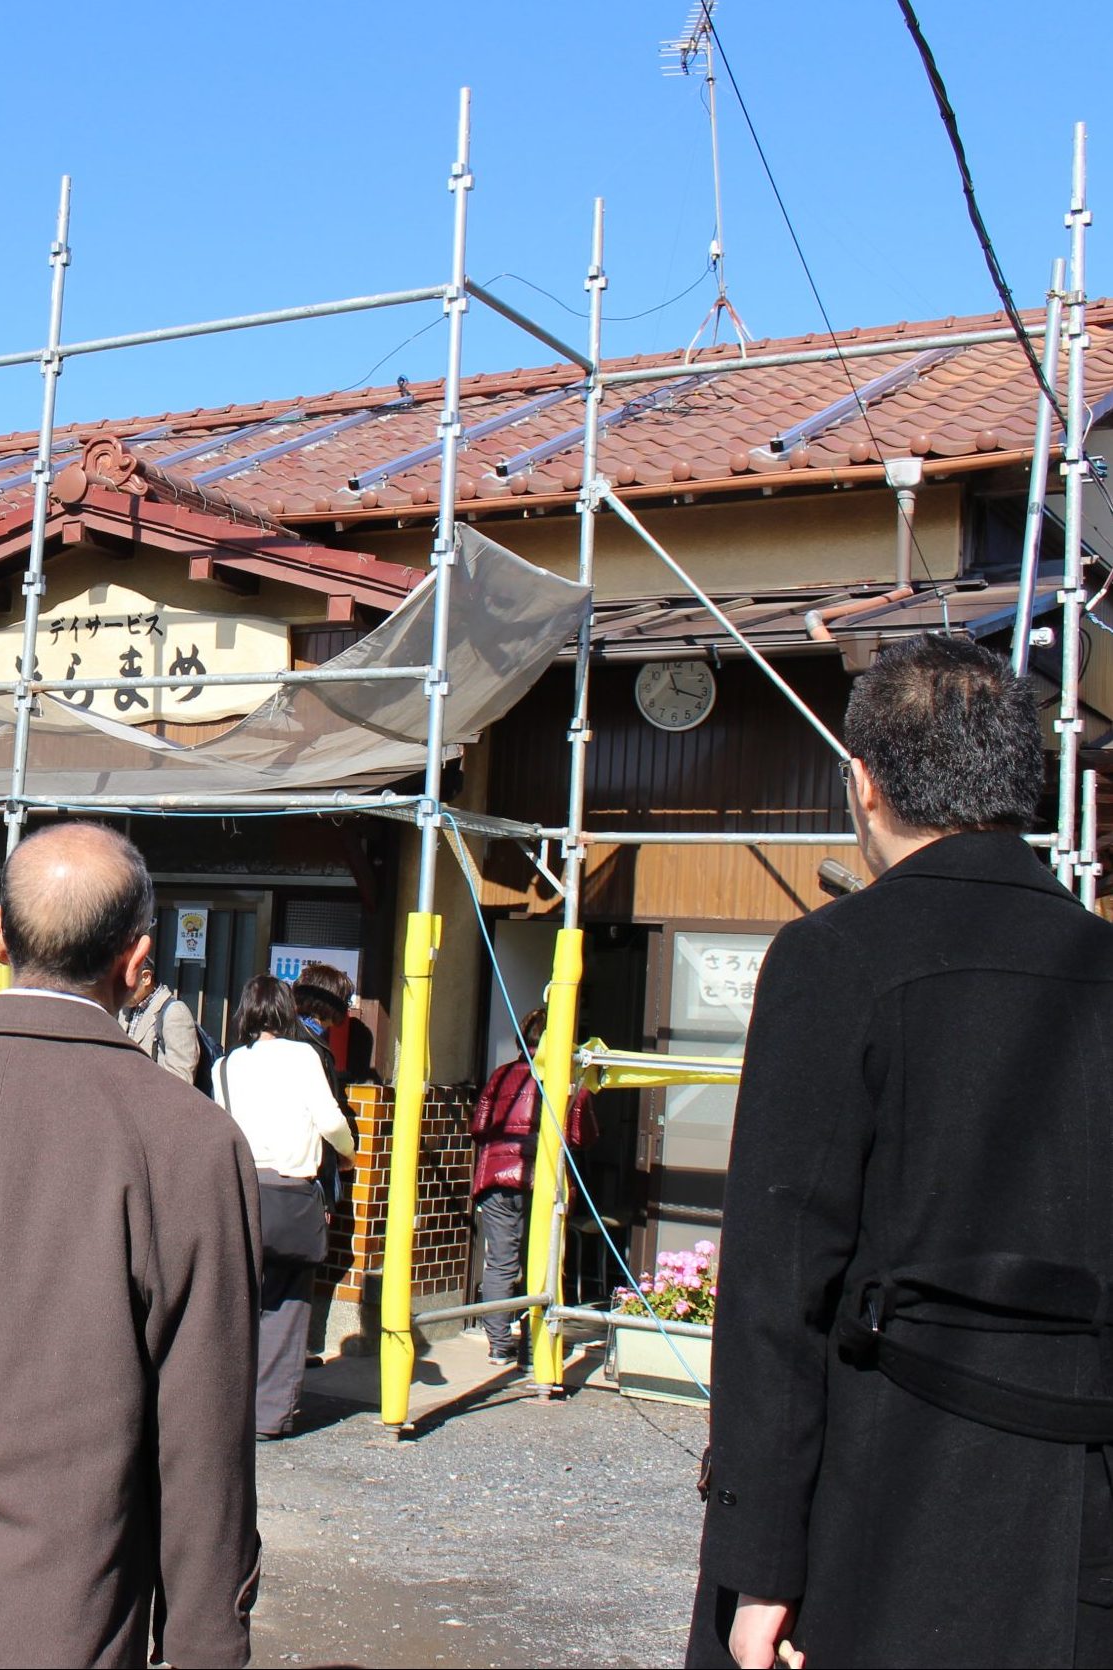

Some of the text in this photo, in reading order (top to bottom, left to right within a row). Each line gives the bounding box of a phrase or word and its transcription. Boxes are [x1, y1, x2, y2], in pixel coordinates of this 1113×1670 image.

[49, 612, 164, 646] デイサービス
[652, 670, 661, 681] 10
[697, 672, 705, 683] 2
[701, 686, 708, 697] 3
[649, 697, 655, 708] 8
[694, 700, 702, 710] 4
[659, 706, 666, 718] 7
[670, 711, 678, 722] 6
[684, 709, 691, 720] 5
